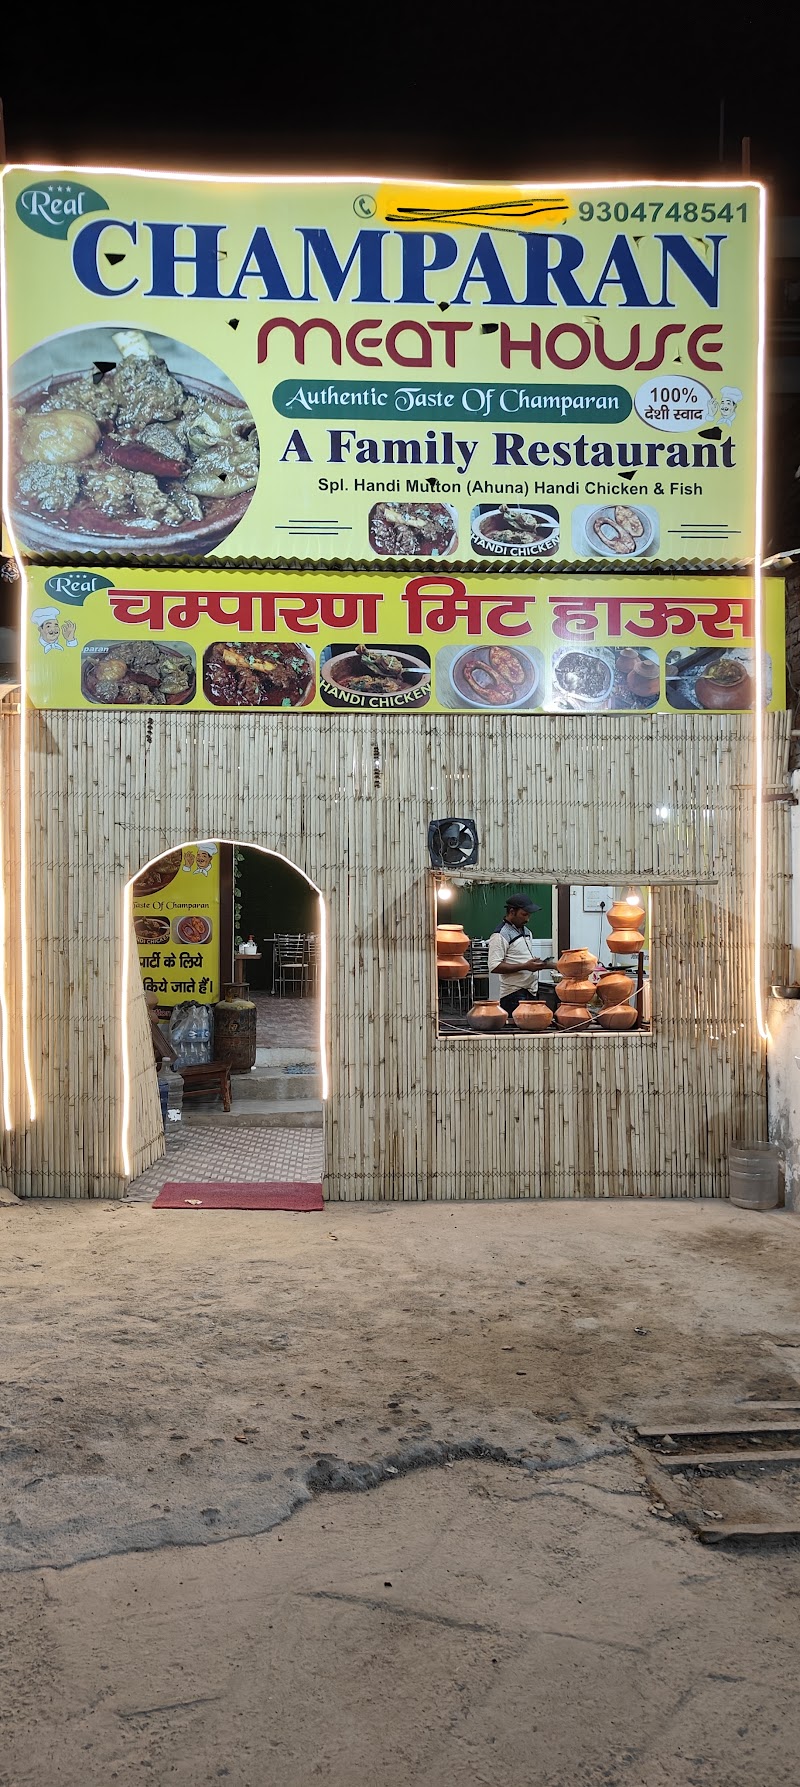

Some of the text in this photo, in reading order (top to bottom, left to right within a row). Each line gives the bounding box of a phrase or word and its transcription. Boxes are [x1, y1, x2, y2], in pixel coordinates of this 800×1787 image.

[21, 189, 86, 226] Real
[578, 201, 749, 224] 9304748541
[72, 219, 727, 307] CHAMPARAN
[257, 316, 724, 372] MEAT HOUSE
[285, 386, 620, 417] Authentic Taste Of Champaran
[650, 387, 698, 403] 100%
[644, 404, 704, 420] देशी स्वाद
[279, 429, 737, 475] A Family Restaurant
[318, 478, 349, 492] Spl.
[354, 479, 400, 492] Handi
[466, 480, 529, 497] (Ahuna)
[534, 482, 580, 495] Handi
[584, 482, 648, 496] Chicken
[653, 483, 665, 495] &
[670, 483, 703, 496] Fish
[471, 533, 560, 556] HANDI CHICKEN
[49, 577, 97, 597] Real
[107, 589, 384, 635] चम्पारण
[400, 576, 536, 638] मिट
[320, 679, 432, 708] HANDI CHICKEN
[152, 901, 164, 911] Of
[166, 902, 210, 911] Champaran
[163, 952, 176, 968] के
[179, 951, 203, 969] लिये
[143, 976, 168, 993] किये
[170, 977, 195, 993] जाते
